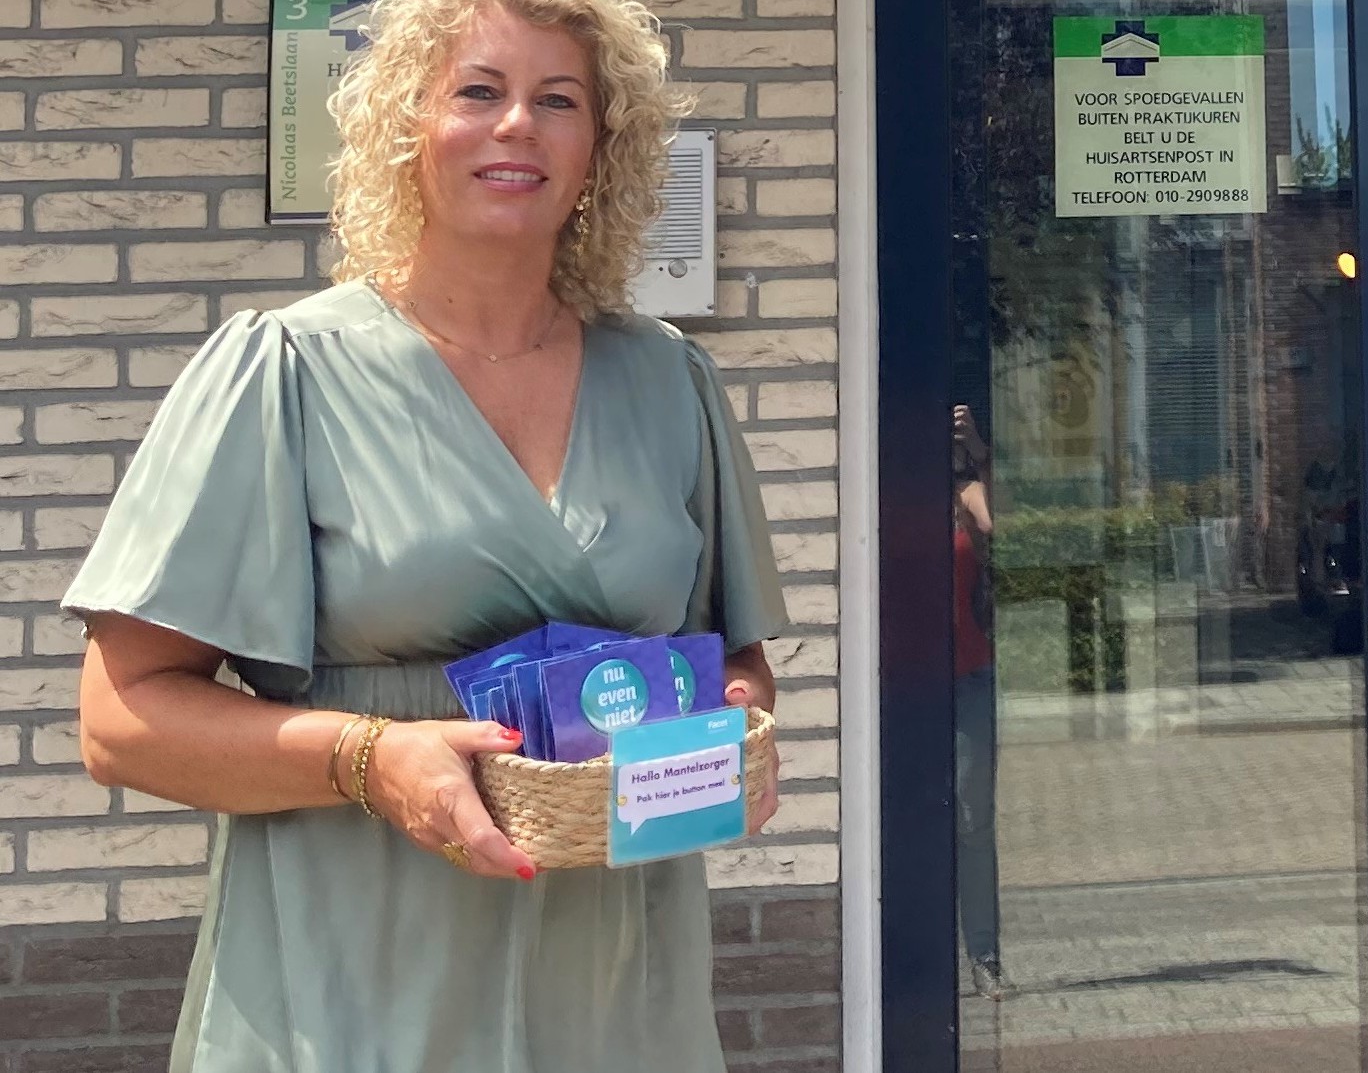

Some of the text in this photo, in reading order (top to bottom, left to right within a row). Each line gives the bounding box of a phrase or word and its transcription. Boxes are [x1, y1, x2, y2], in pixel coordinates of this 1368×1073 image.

[1074, 91, 1244, 106] VOOR SPOEDGEVALLEN
[281, 31, 299, 201] Nicolaas Beetslaan
[1078, 111, 1240, 126] BUITEN PRAKTIJKUREN
[1124, 131, 1196, 144] BELT U DE
[1086, 150, 1234, 165] HUISARTSENPOST IN
[1114, 170, 1207, 184] ROTTERDAM
[1072, 189, 1249, 205] TELEFOON: 010-2909888
[603, 666, 626, 684] nu
[597, 685, 638, 707] even
[604, 705, 638, 728] niet
[631, 758, 730, 784] Hallo Mantelzorger
[636, 794, 652, 804] Pak
[655, 790, 671, 801] hier
[682, 784, 706, 795] button
